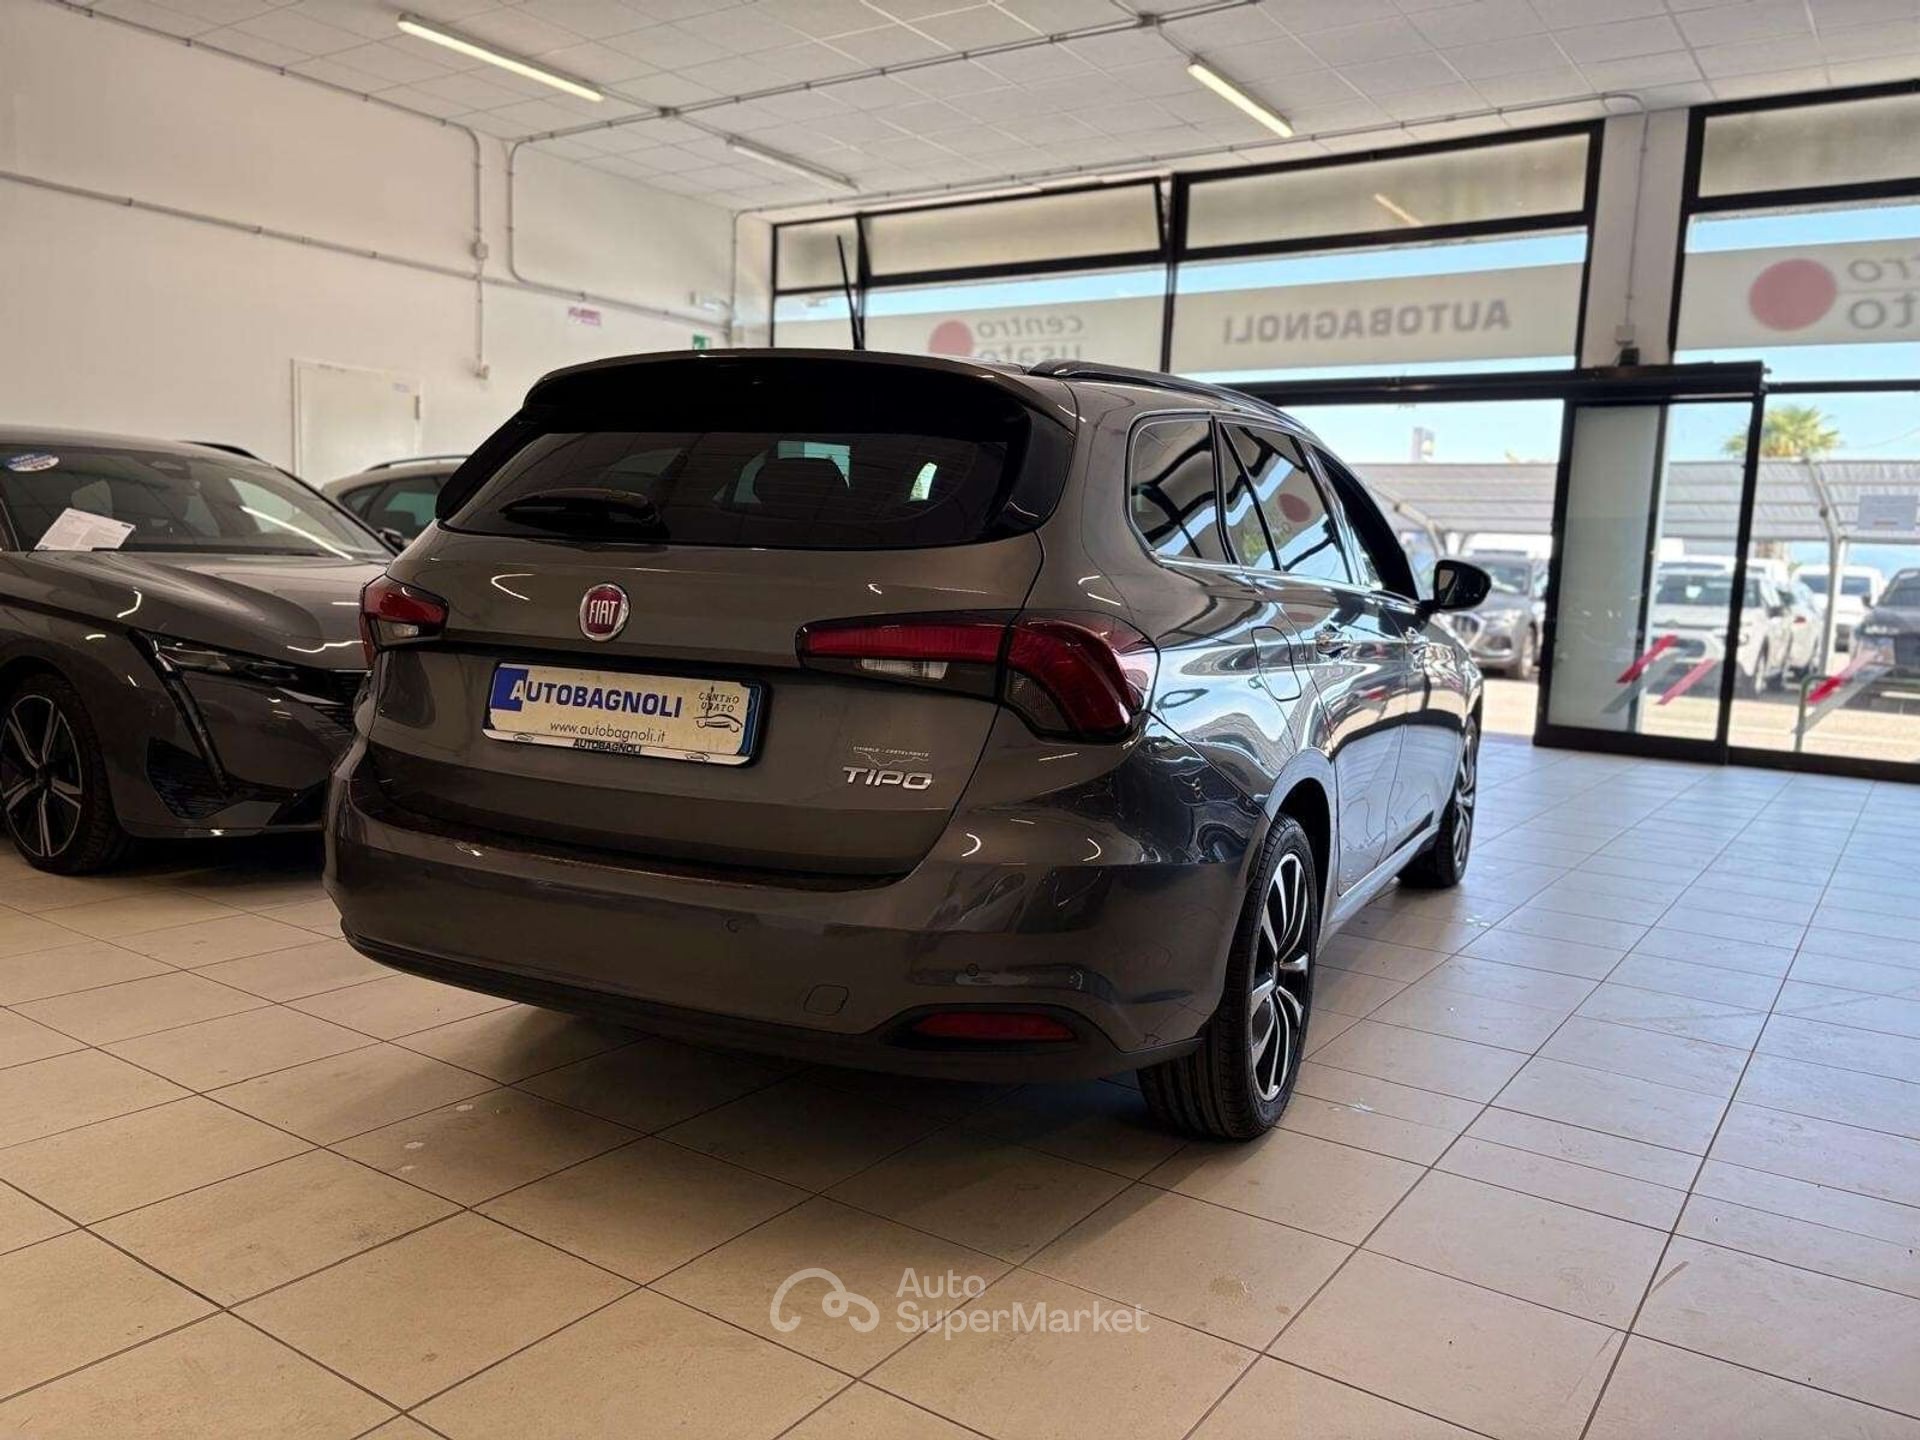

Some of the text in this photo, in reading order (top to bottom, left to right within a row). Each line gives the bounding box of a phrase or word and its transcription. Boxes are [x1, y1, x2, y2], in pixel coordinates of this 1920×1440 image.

[589, 599, 619, 625] FIAT
[509, 679, 683, 718] AUTOBAGNOLI
[698, 691, 740, 705] CENTRO
[550, 721, 666, 743] www.autobagnoli.it
[573, 737, 642, 755] AUTOBAGNOLI
[842, 765, 934, 790] TIPO
